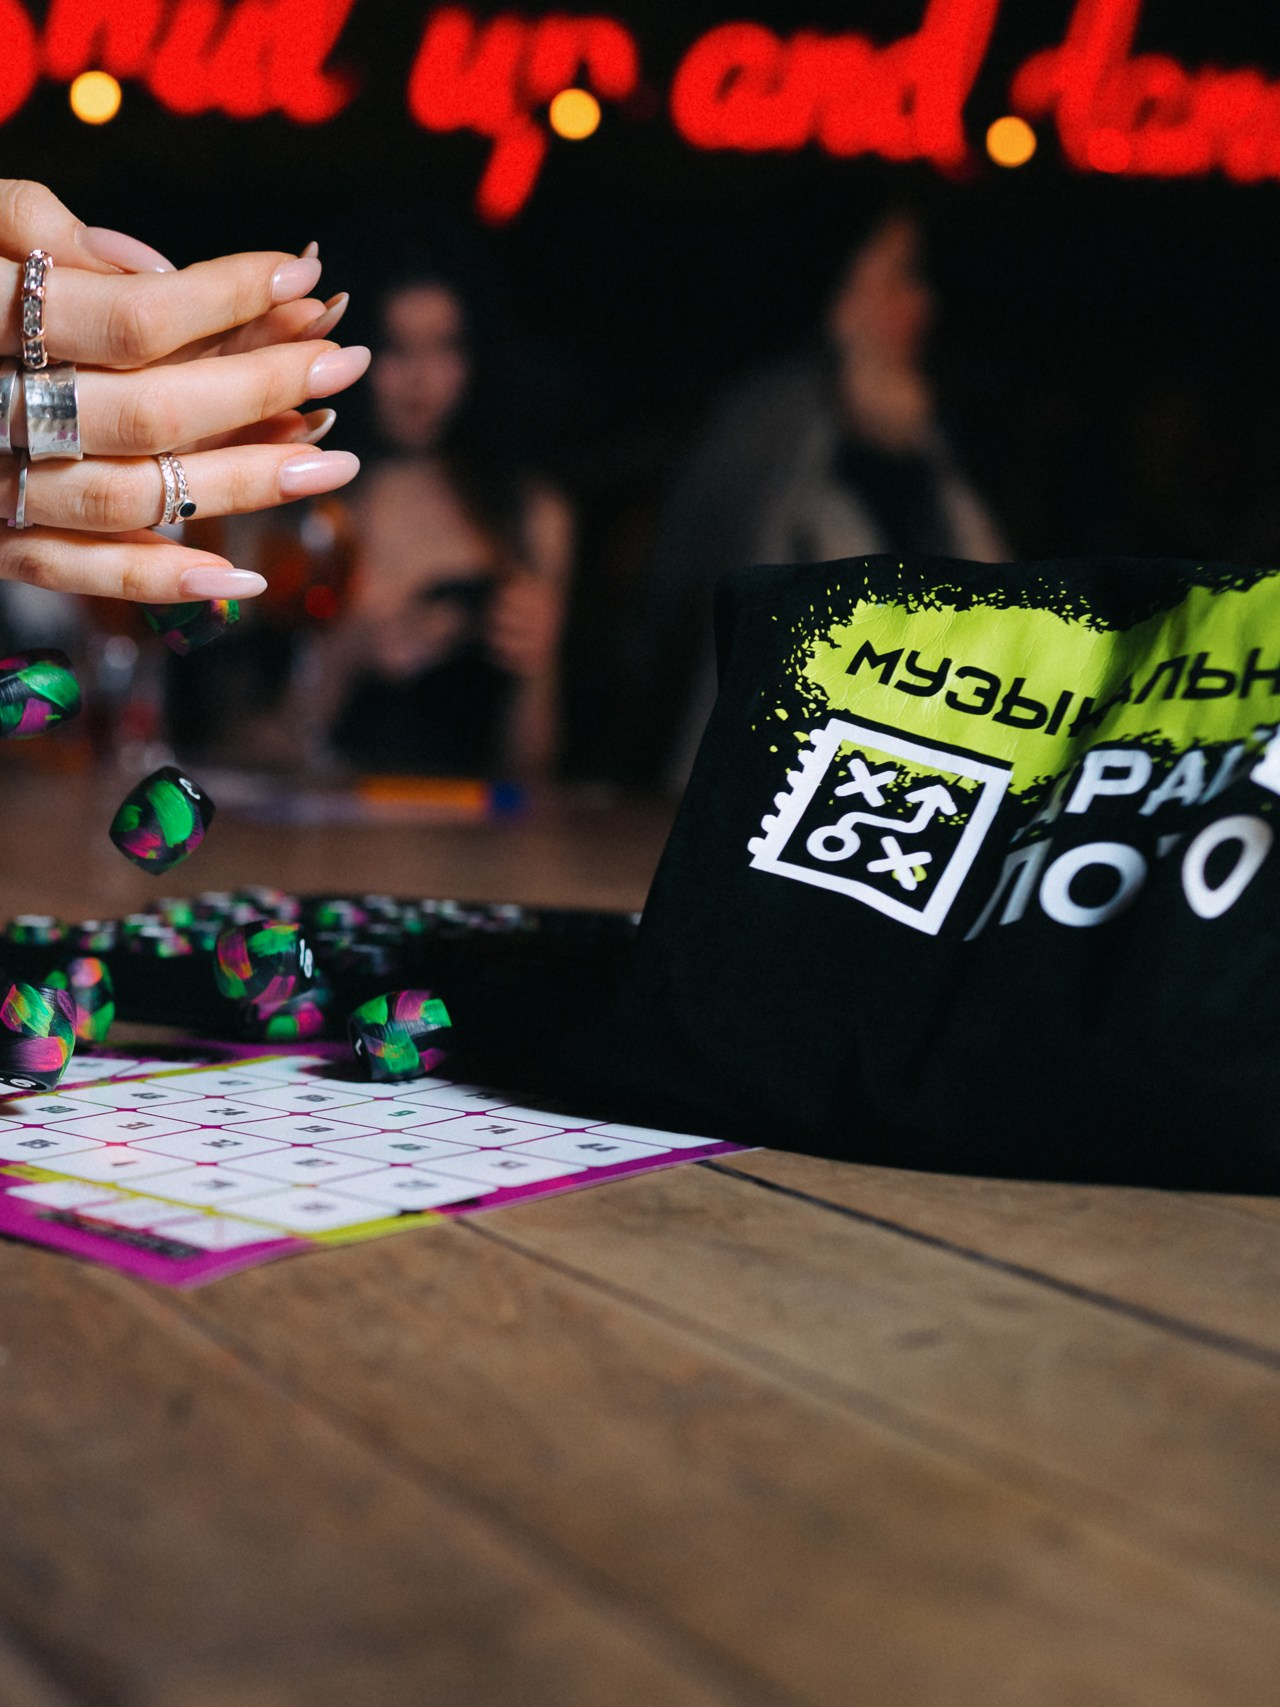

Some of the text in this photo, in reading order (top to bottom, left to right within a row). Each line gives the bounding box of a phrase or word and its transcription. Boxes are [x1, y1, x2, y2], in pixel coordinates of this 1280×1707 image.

[963, 814, 1273, 941] ЛОО
[299, 938, 313, 978] 18
[116, 1121, 156, 1130] 31
[473, 1124, 518, 1135] 74
